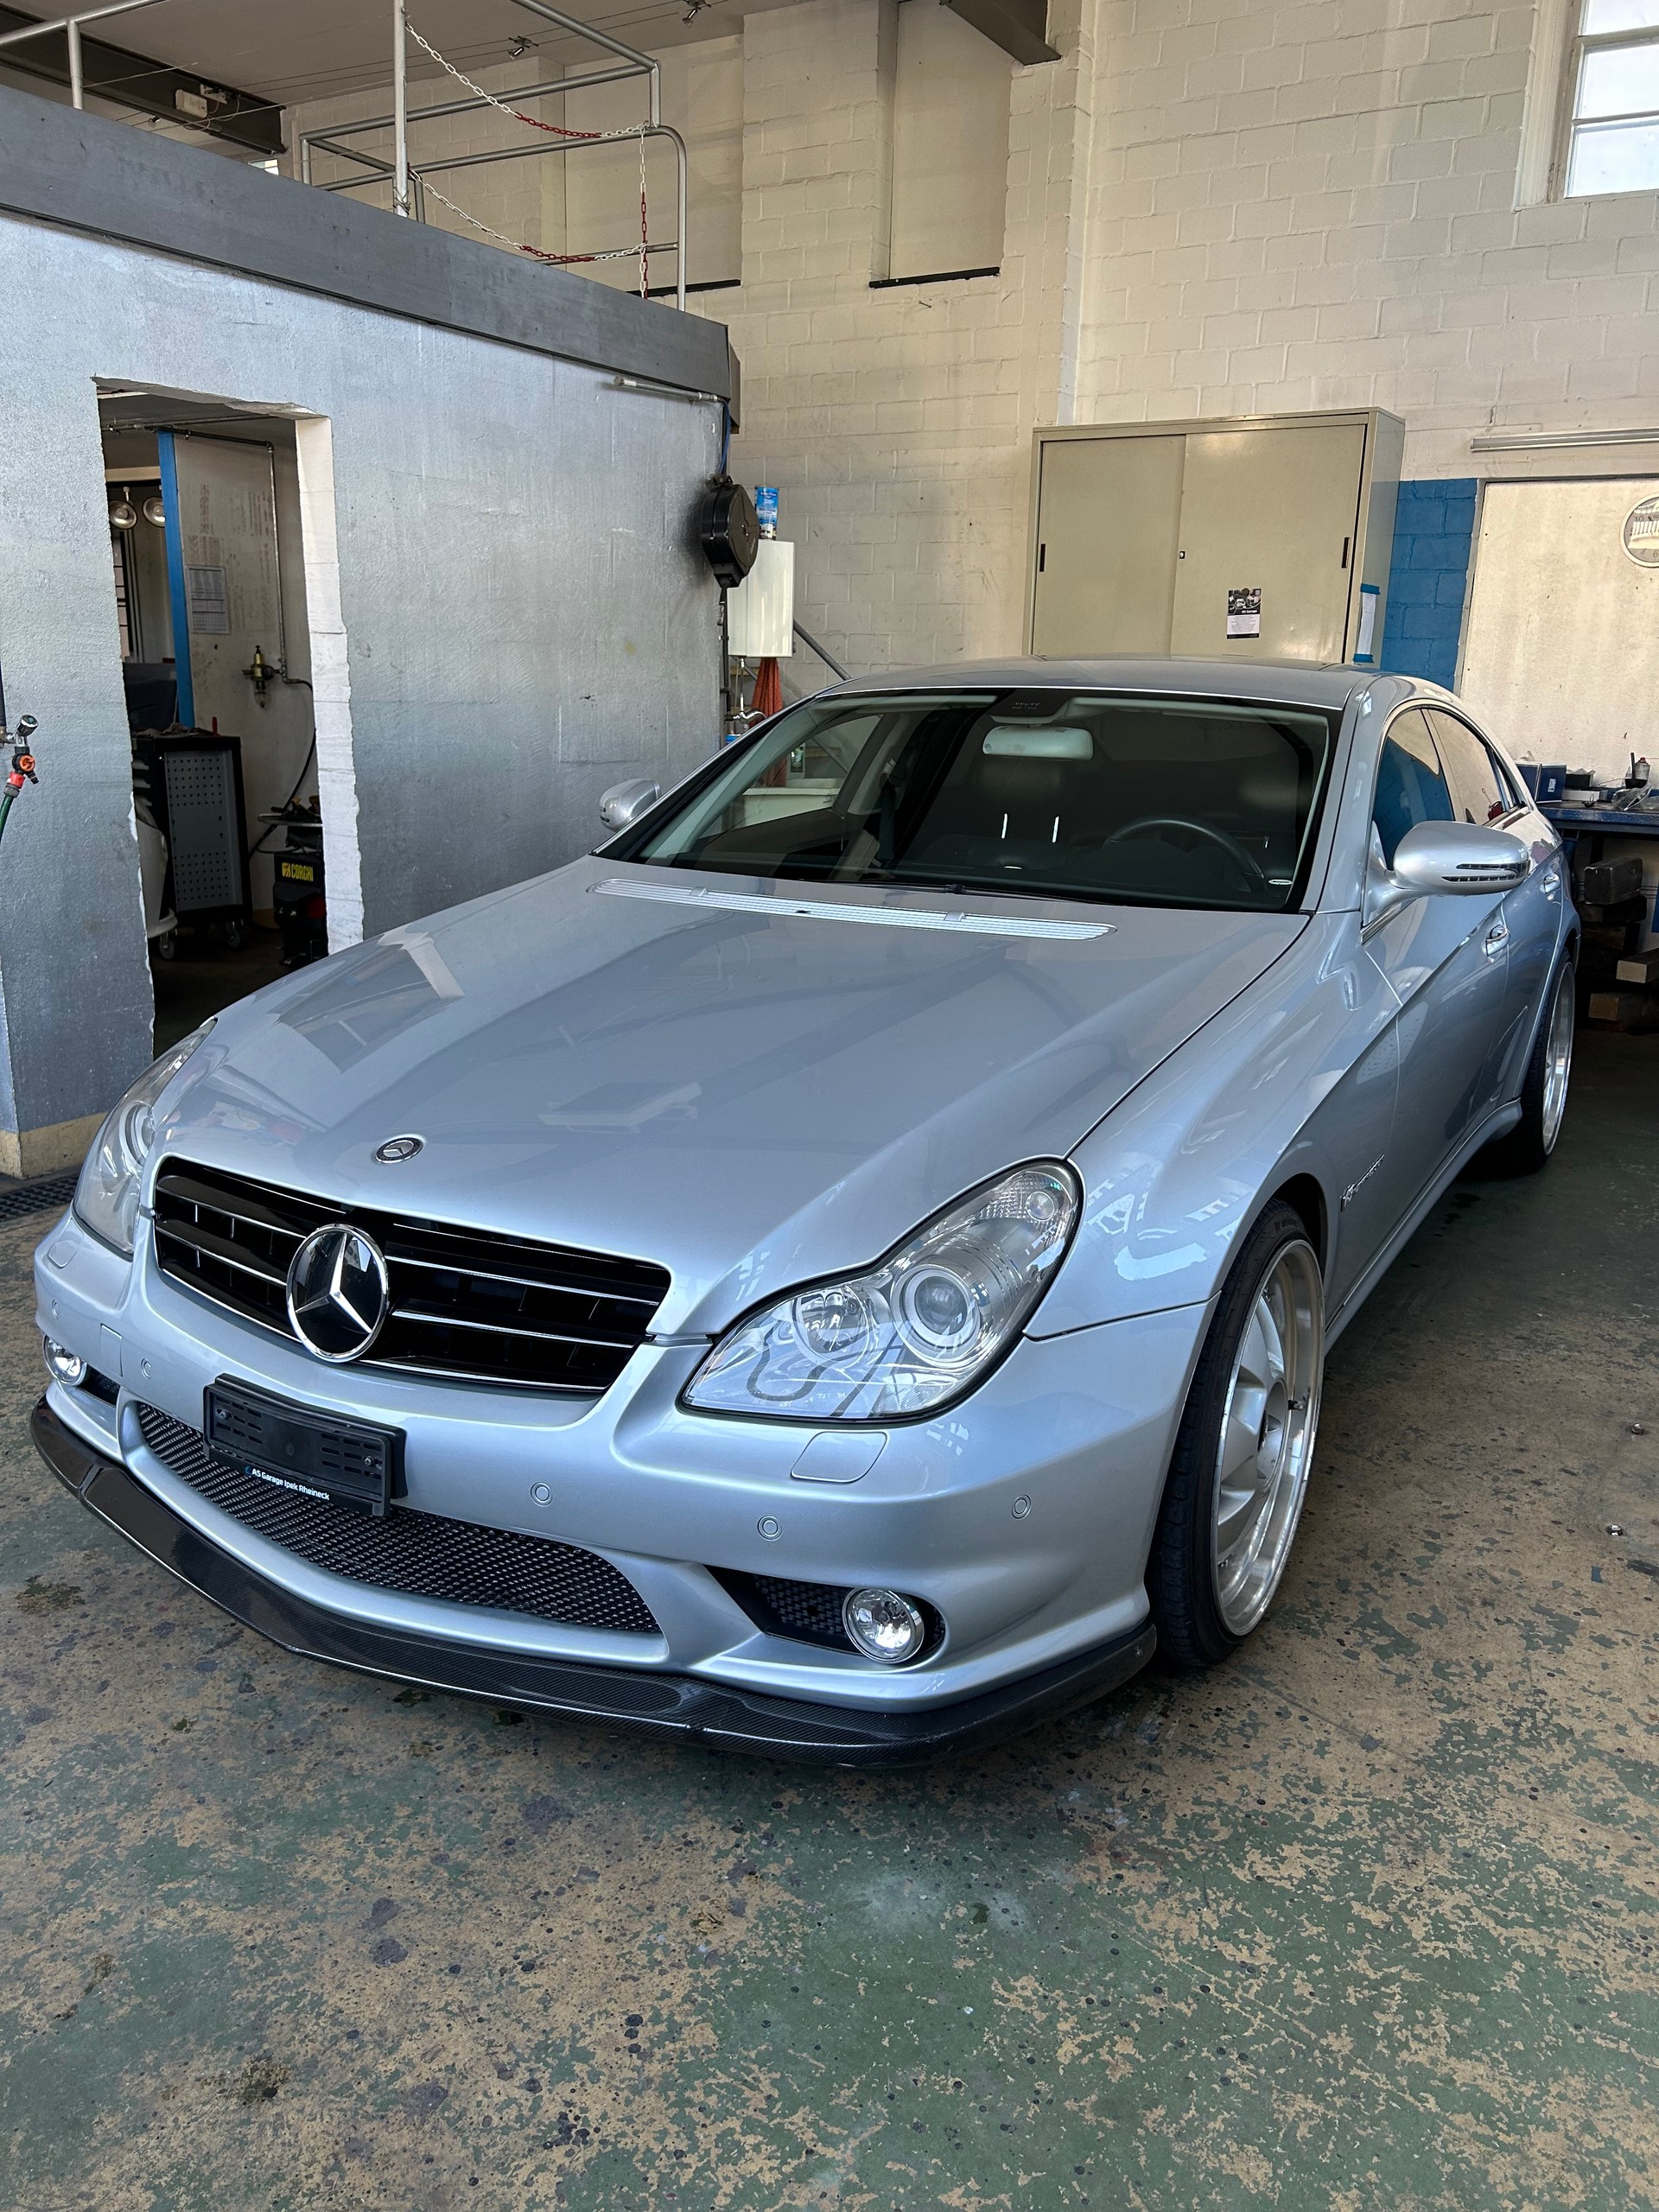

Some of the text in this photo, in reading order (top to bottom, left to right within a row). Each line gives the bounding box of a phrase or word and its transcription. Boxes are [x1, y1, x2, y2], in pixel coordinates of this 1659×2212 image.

[290, 863, 314, 881] CORGHI
[262, 1472, 283, 1485] Garage
[284, 1480, 298, 1491] Ipek
[299, 1485, 329, 1500] Rheineck
